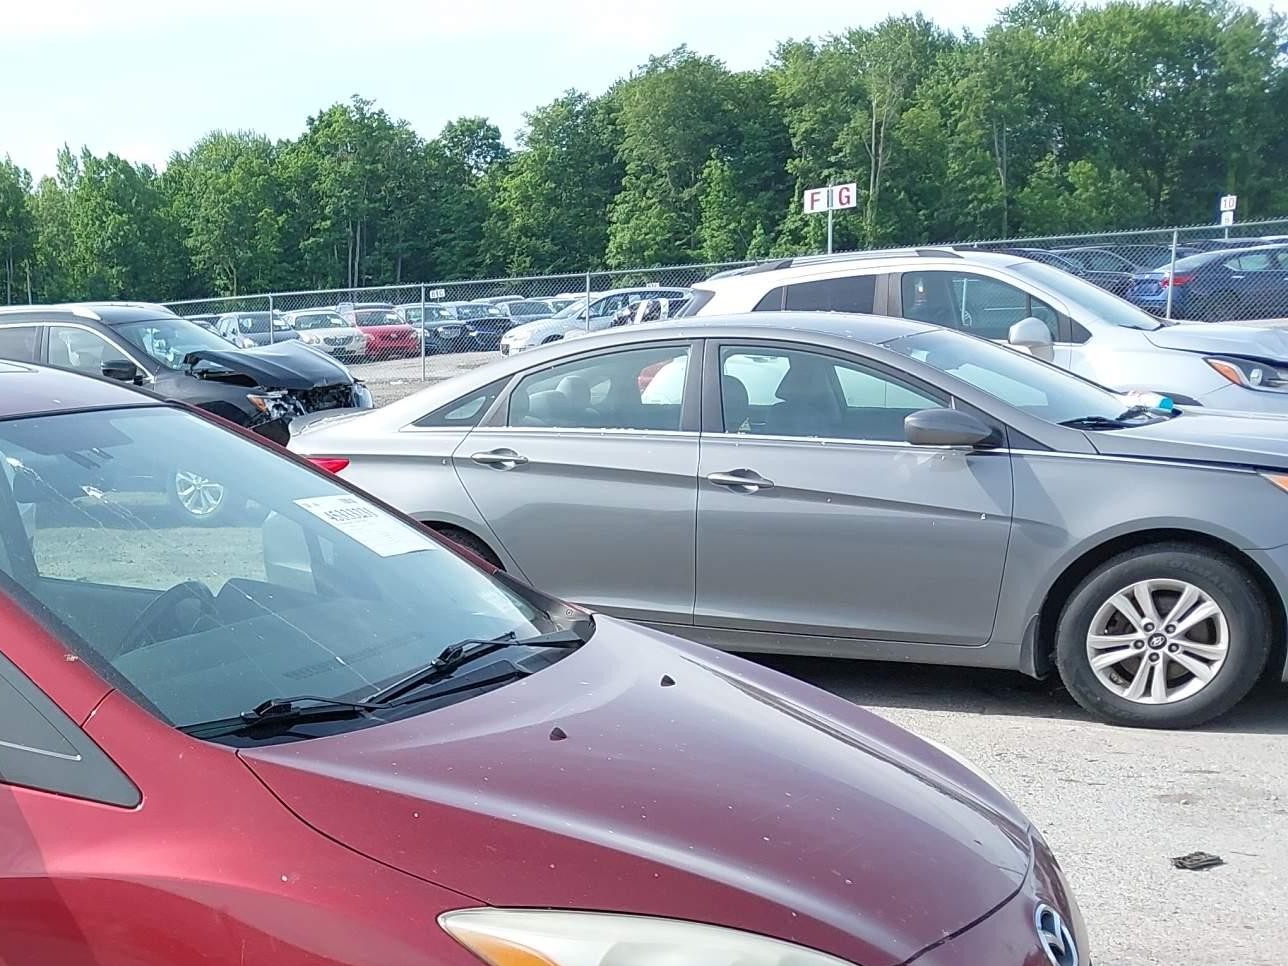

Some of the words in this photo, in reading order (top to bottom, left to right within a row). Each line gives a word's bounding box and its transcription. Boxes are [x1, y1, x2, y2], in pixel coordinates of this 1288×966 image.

[810, 191, 821, 210] F
[838, 187, 851, 206] G
[1223, 197, 1235, 209] 10
